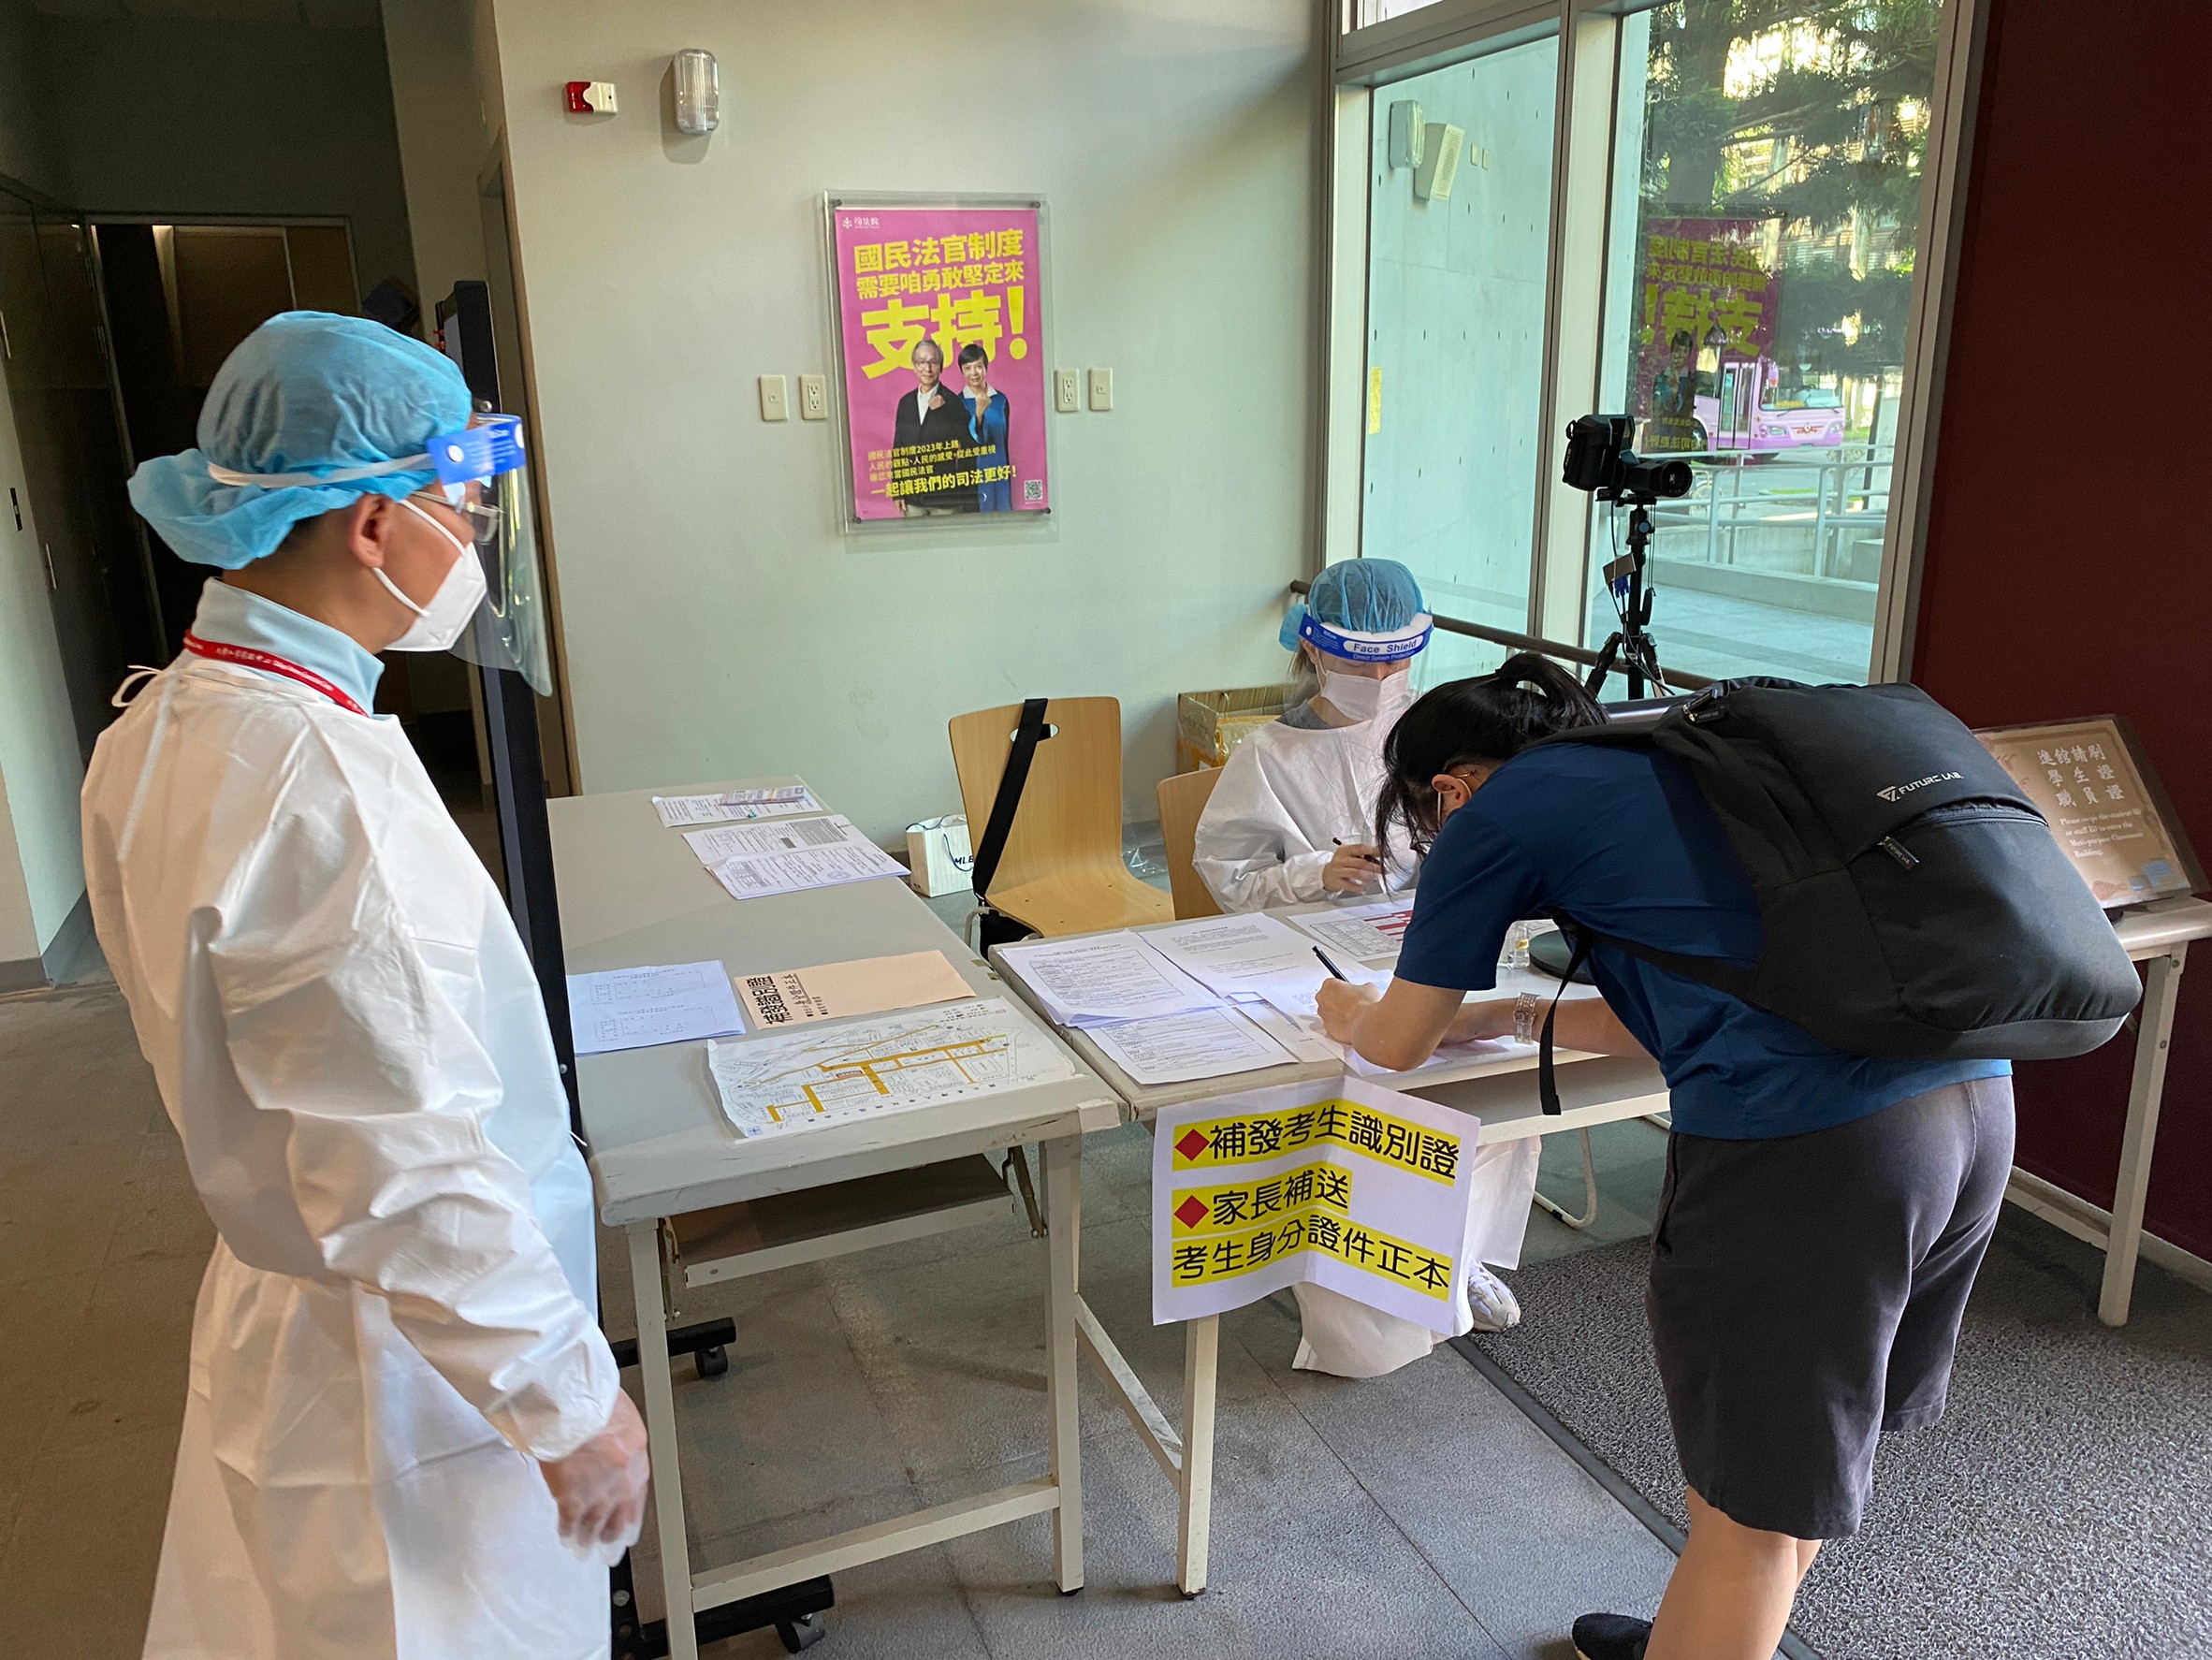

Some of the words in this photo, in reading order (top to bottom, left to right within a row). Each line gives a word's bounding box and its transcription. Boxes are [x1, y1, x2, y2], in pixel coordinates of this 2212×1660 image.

[853, 228, 1025, 274] 國民法官制度
[856, 259, 1025, 299] 需要咱勇敢堅定來
[867, 440, 959, 461] 國民法官制度2023年上路
[1353, 643, 1380, 653] Face
[1387, 640, 1417, 652] Shield
[2037, 744, 2106, 766] 進館請刷
[1899, 775, 1942, 794] FUTURE
[1942, 771, 1963, 780] LAB
[2047, 764, 2116, 787] 學生證
[2056, 784, 2125, 807] 職員證
[1209, 1104, 1460, 1180] 補發考生識別證
[1213, 1168, 1349, 1226] 家長補送
[1172, 1214, 1449, 1290] 考生身分證件正本
